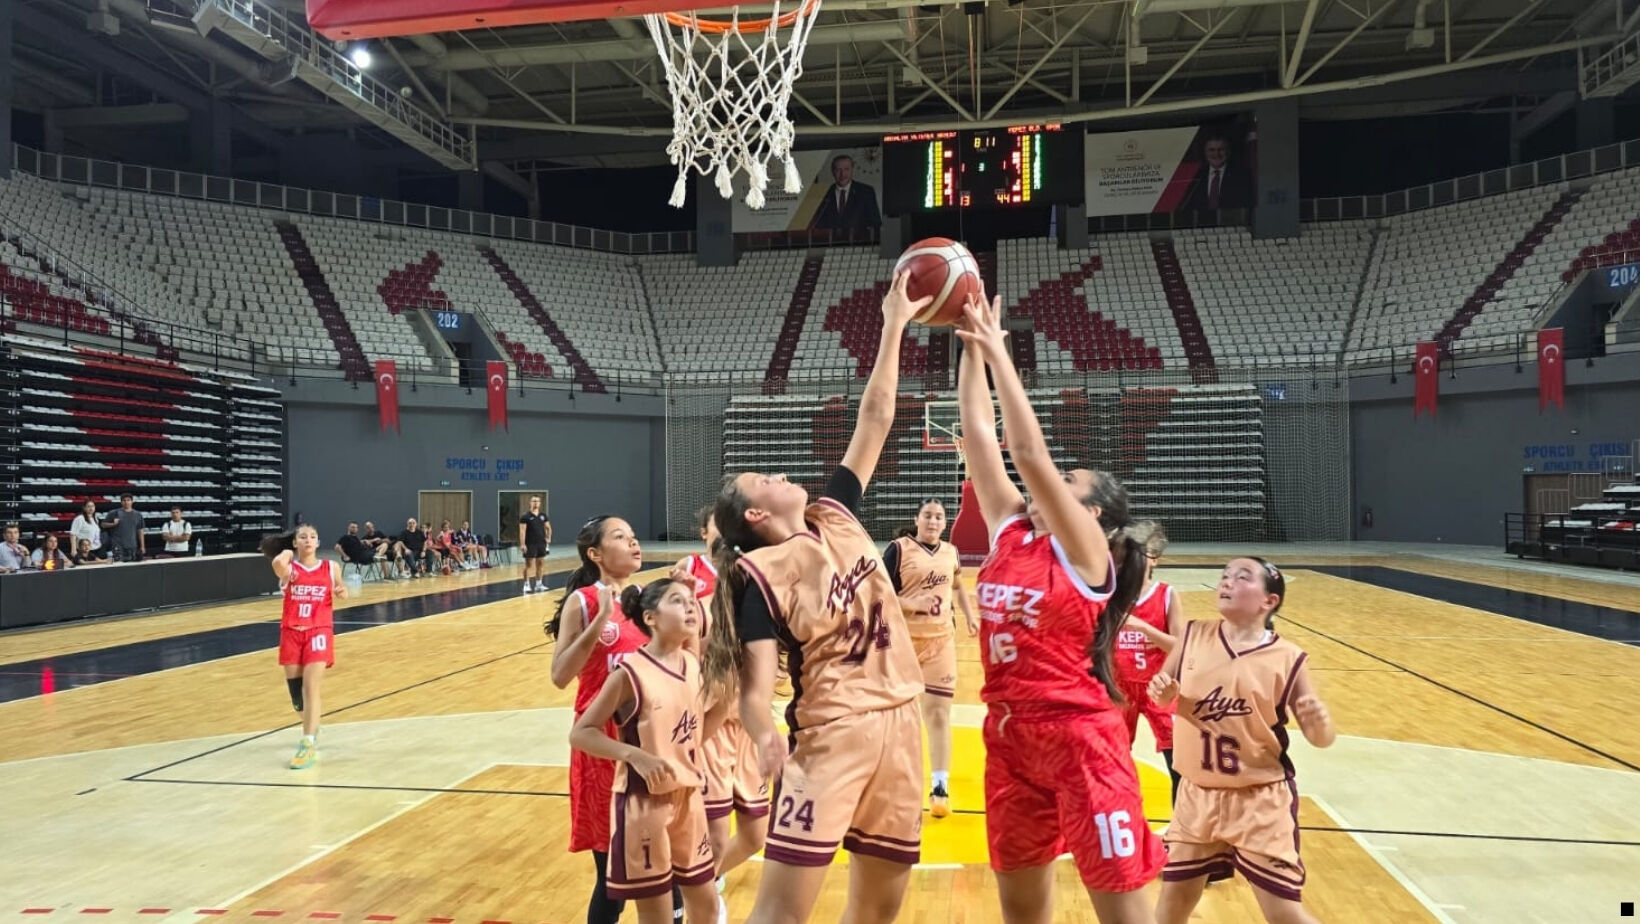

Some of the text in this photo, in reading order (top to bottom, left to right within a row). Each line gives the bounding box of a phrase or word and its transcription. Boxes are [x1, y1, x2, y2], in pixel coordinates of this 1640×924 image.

[997, 194, 1010, 203] 44
[438, 312, 458, 328] 202
[1524, 445, 1574, 458] SPORCU
[446, 457, 486, 469] SPORCU
[826, 555, 878, 620] Aya
[921, 570, 949, 589] Aya
[290, 584, 327, 597] KEPEZ
[299, 603, 312, 618] 10
[840, 601, 892, 665] 24
[311, 634, 327, 652] 10
[989, 632, 1018, 664] 16
[1134, 652, 1147, 670] 5
[1192, 686, 1253, 722] Aya
[1200, 729, 1241, 775] 16
[779, 795, 814, 832] 24
[1094, 810, 1136, 859] 16
[643, 844, 652, 869] 1
